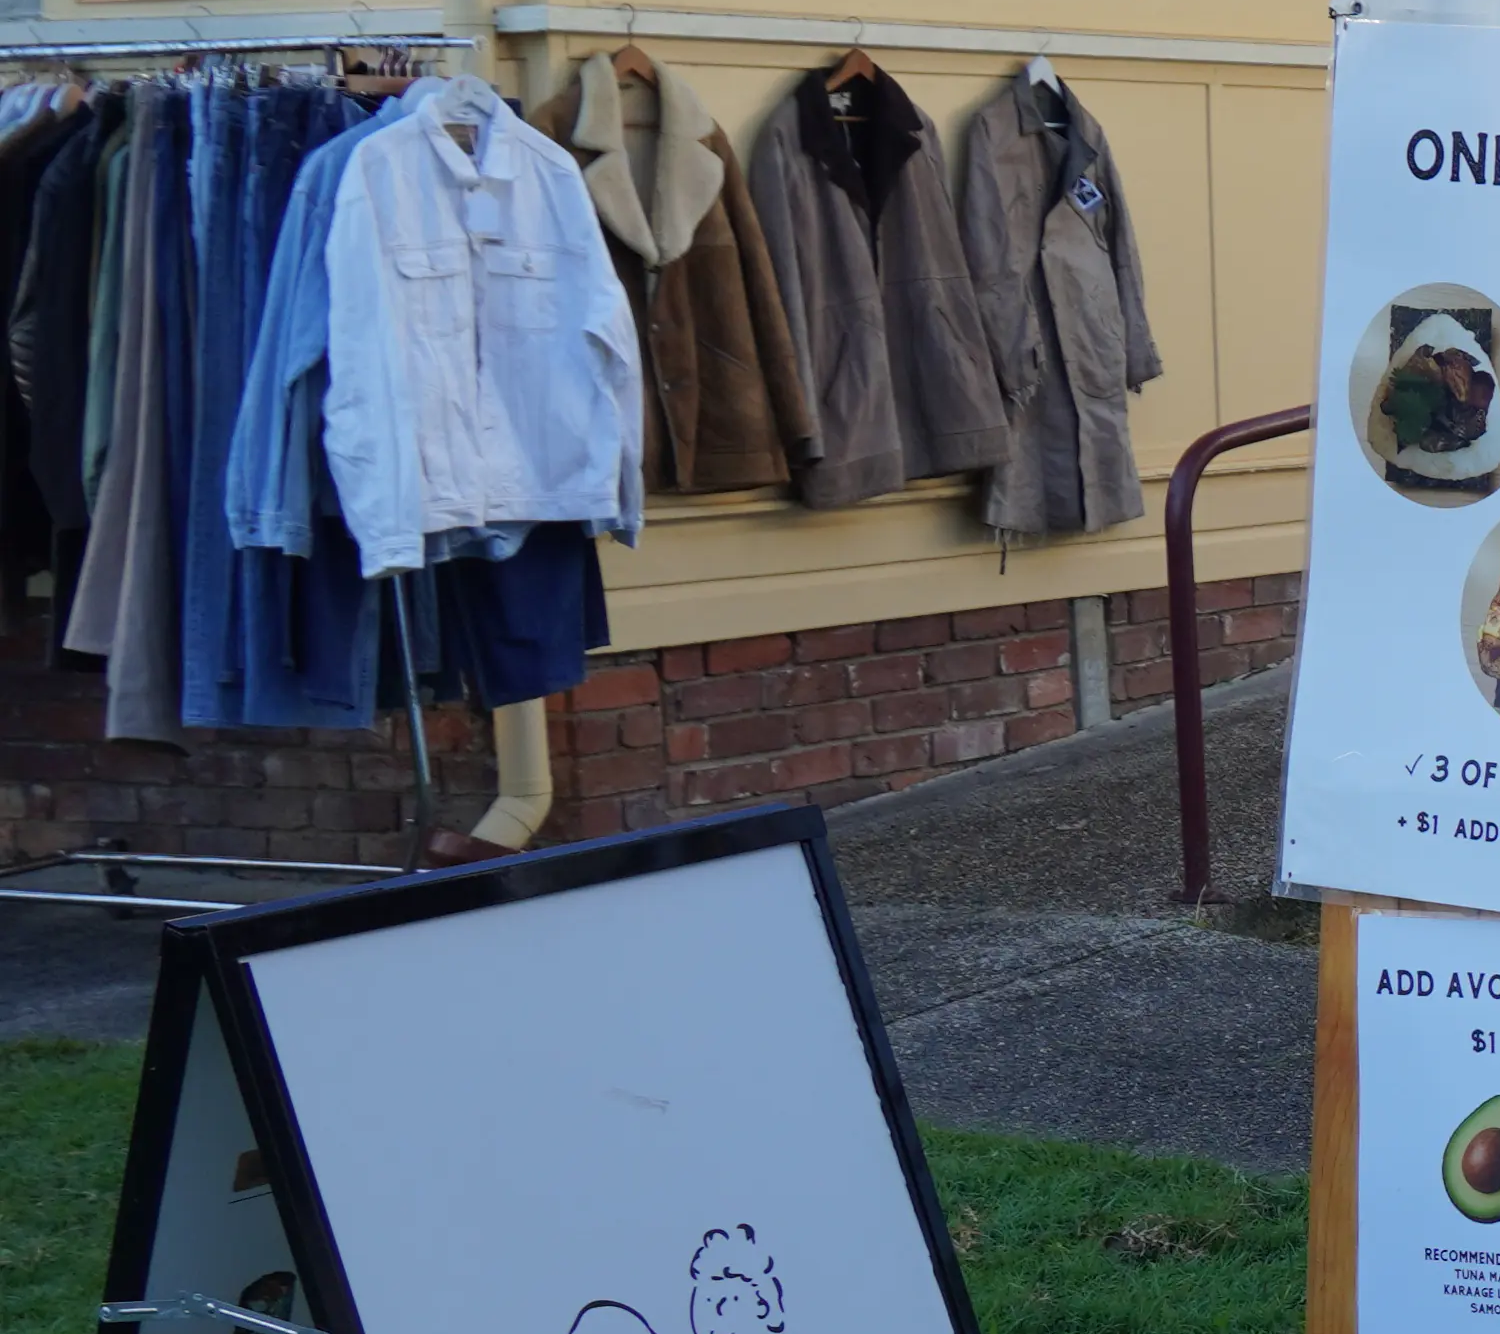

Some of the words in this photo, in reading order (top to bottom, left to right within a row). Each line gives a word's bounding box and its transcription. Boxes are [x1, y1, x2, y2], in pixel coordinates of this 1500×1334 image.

[1430, 754, 1450, 784] 3
[1460, 759, 1500, 789] OF
[1416, 810, 1440, 838] $1
[1454, 815, 1500, 844] ADD
[1376, 969, 1434, 999] ADD
[1471, 1029, 1496, 1055] $1
[1455, 1268, 1486, 1282] TUNA
[1443, 1284, 1494, 1298] KARAAGE
